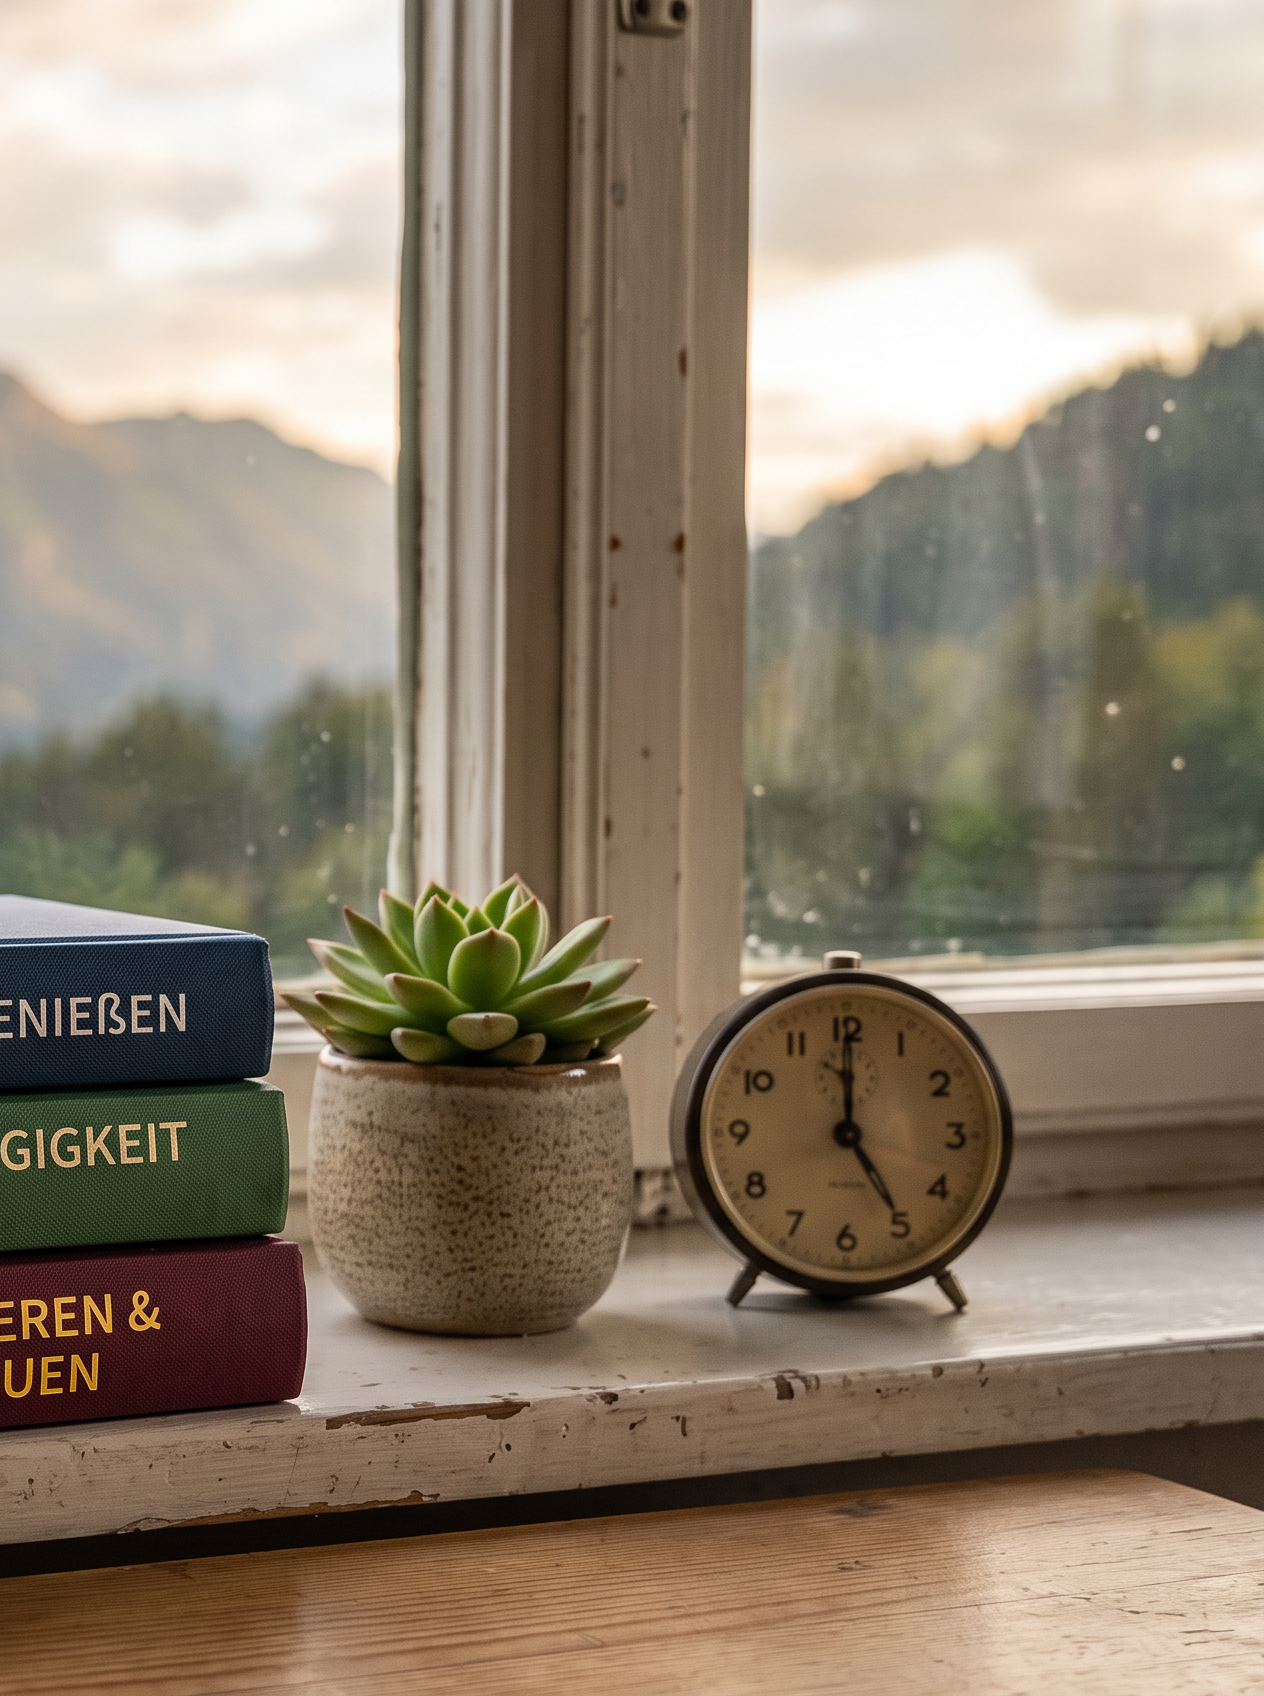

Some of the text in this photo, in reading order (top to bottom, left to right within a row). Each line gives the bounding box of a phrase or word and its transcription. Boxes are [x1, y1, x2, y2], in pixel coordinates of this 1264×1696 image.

[832, 1014, 863, 1043] 12
[786, 1030, 806, 1057] 11
[896, 1029, 905, 1058] 1
[743, 1068, 775, 1096] 10
[927, 1068, 952, 1098] 2
[728, 1118, 751, 1146] 9
[944, 1121, 967, 1151] 3
[744, 1170, 767, 1199] 8
[926, 1173, 950, 1201] 4
[785, 1209, 805, 1237] 7
[835, 1223, 858, 1252] 6
[889, 1210, 911, 1240] 5
[128, 1289, 162, 1333] &
